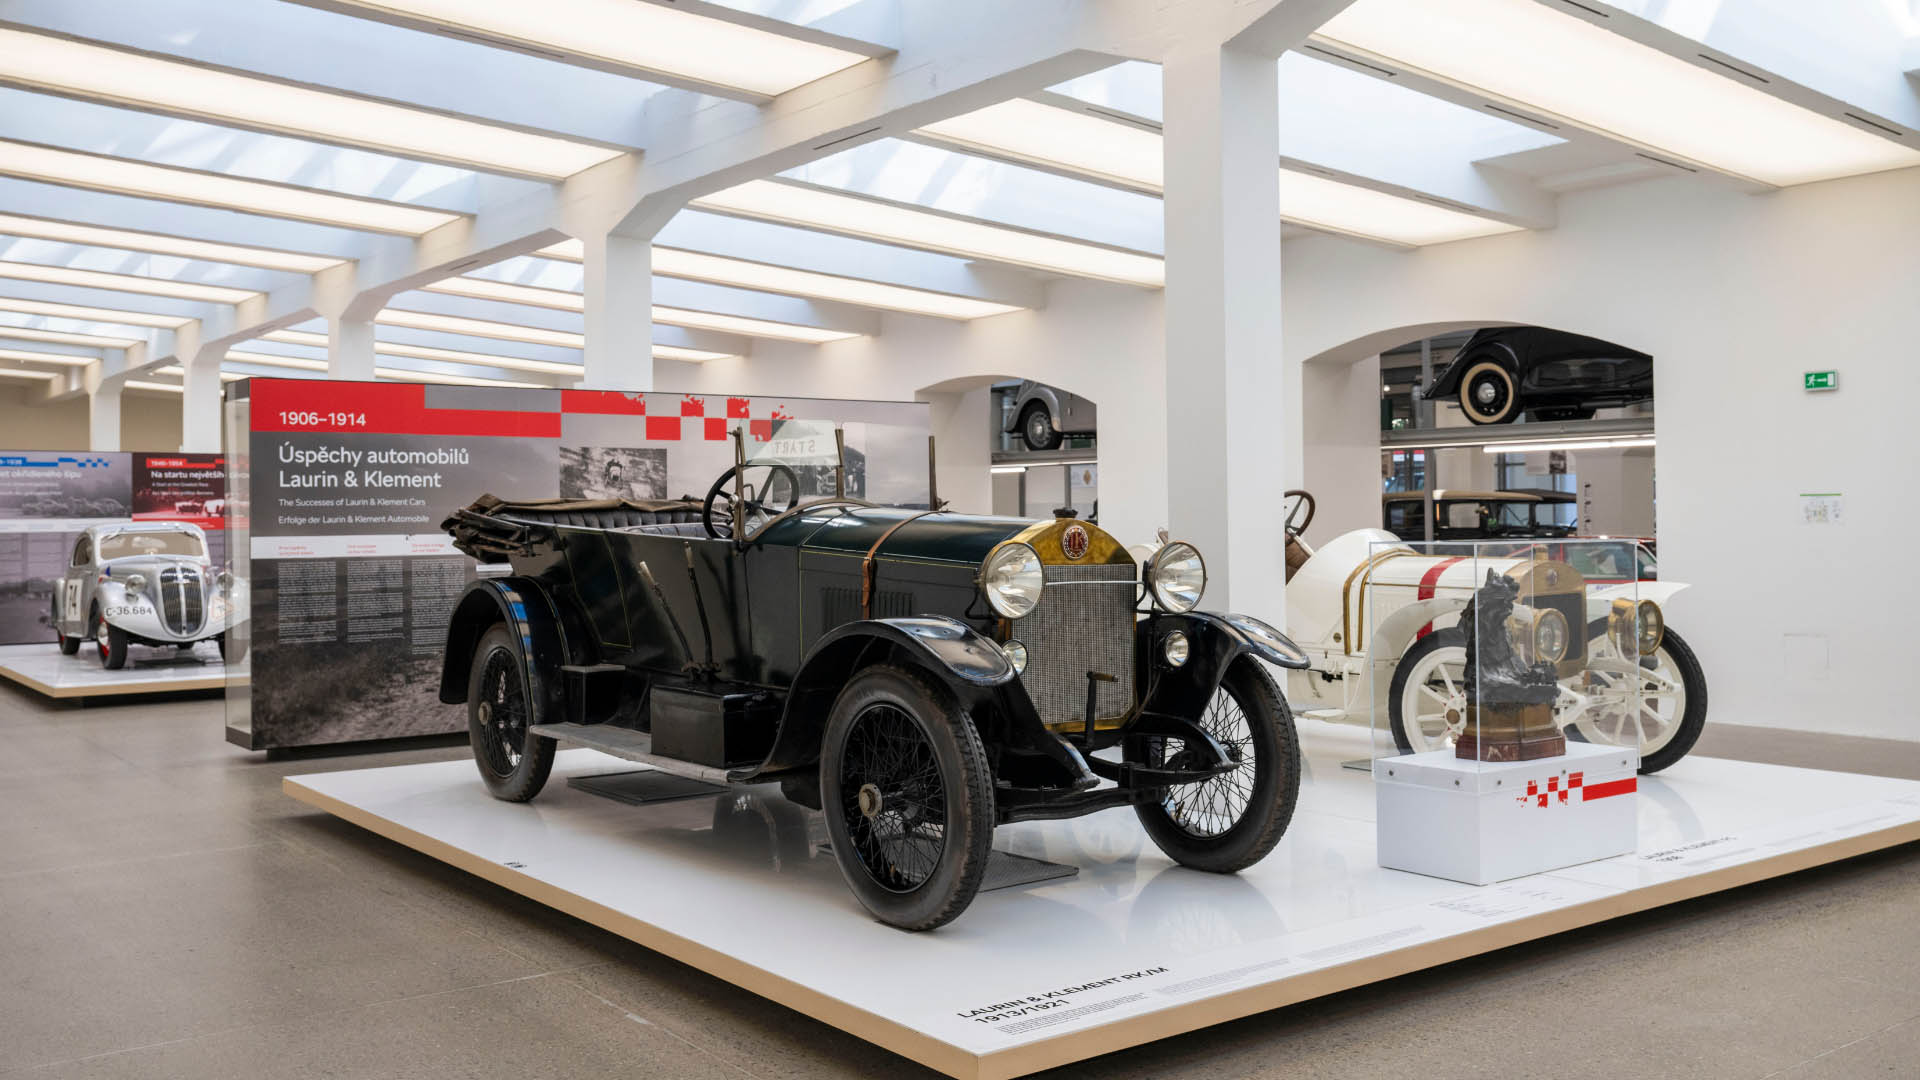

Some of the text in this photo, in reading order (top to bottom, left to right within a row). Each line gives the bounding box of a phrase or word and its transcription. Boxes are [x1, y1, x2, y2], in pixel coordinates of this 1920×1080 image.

[279, 441, 469, 467] Úspěchy automobilů
[279, 471, 442, 488] Laurin & Klement
[278, 498, 426, 507] The Successes of Laurin & Klement Cars
[278, 515, 430, 525] Erfolge der Laurin & Klement Automobile
[957, 998, 1028, 1018] LAURIN
[1026, 996, 1043, 1006] &
[1042, 977, 1122, 998] KLEMENT
[974, 999, 1071, 1024] 1913/1921
